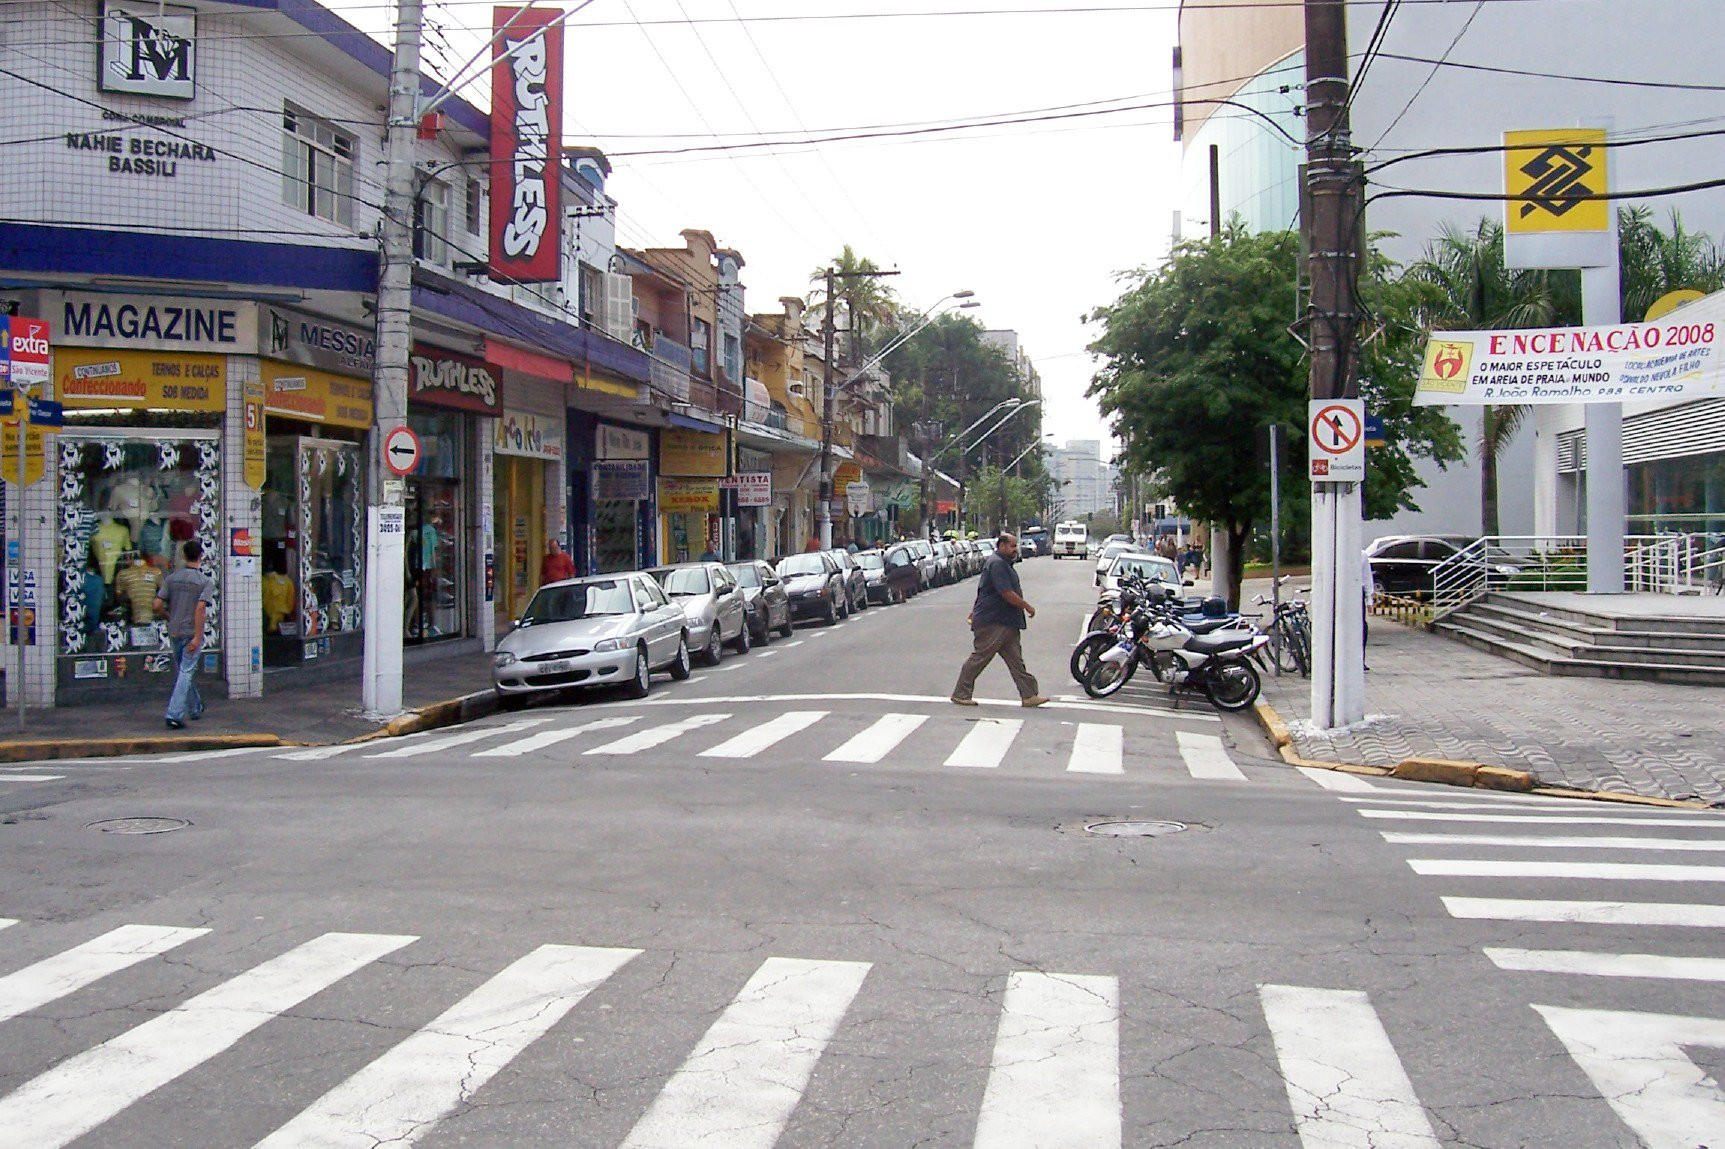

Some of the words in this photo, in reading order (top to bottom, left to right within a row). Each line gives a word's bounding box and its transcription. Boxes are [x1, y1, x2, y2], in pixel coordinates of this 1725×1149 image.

[66, 133, 123, 153] NAHIE
[130, 138, 216, 162] BECHARA
[504, 33, 549, 259] RUTHLESS
[108, 156, 177, 177] BASSILI
[64, 302, 236, 342] MAGAZINE
[13, 335, 48, 355] extra
[1489, 325, 1661, 354] ENCENAÇÃO
[1665, 323, 1715, 346] 2008
[1688, 347, 1711, 358] ARTES
[25, 366, 48, 377] Vicente
[152, 362, 181, 377] TERNOS
[185, 364, 190, 377] E
[192, 364, 220, 382] CALÇAS
[1480, 362, 1487, 371] O
[1490, 361, 1522, 371] MAIOR
[1526, 356, 1601, 371] ESPETÁCULO
[1679, 360, 1701, 374] FILHO
[62, 374, 147, 396] Confeccionando
[410, 356, 496, 406] RUTHLESS
[1472, 375, 1488, 385] EM
[1490, 375, 1518, 385] AREIA
[1521, 375, 1533, 384] DE
[1572, 372, 1610, 384] MUNDO
[1629, 384, 1684, 394] CENTRO
[13, 571, 34, 580] VSA
[13, 591, 34, 599] VSA
